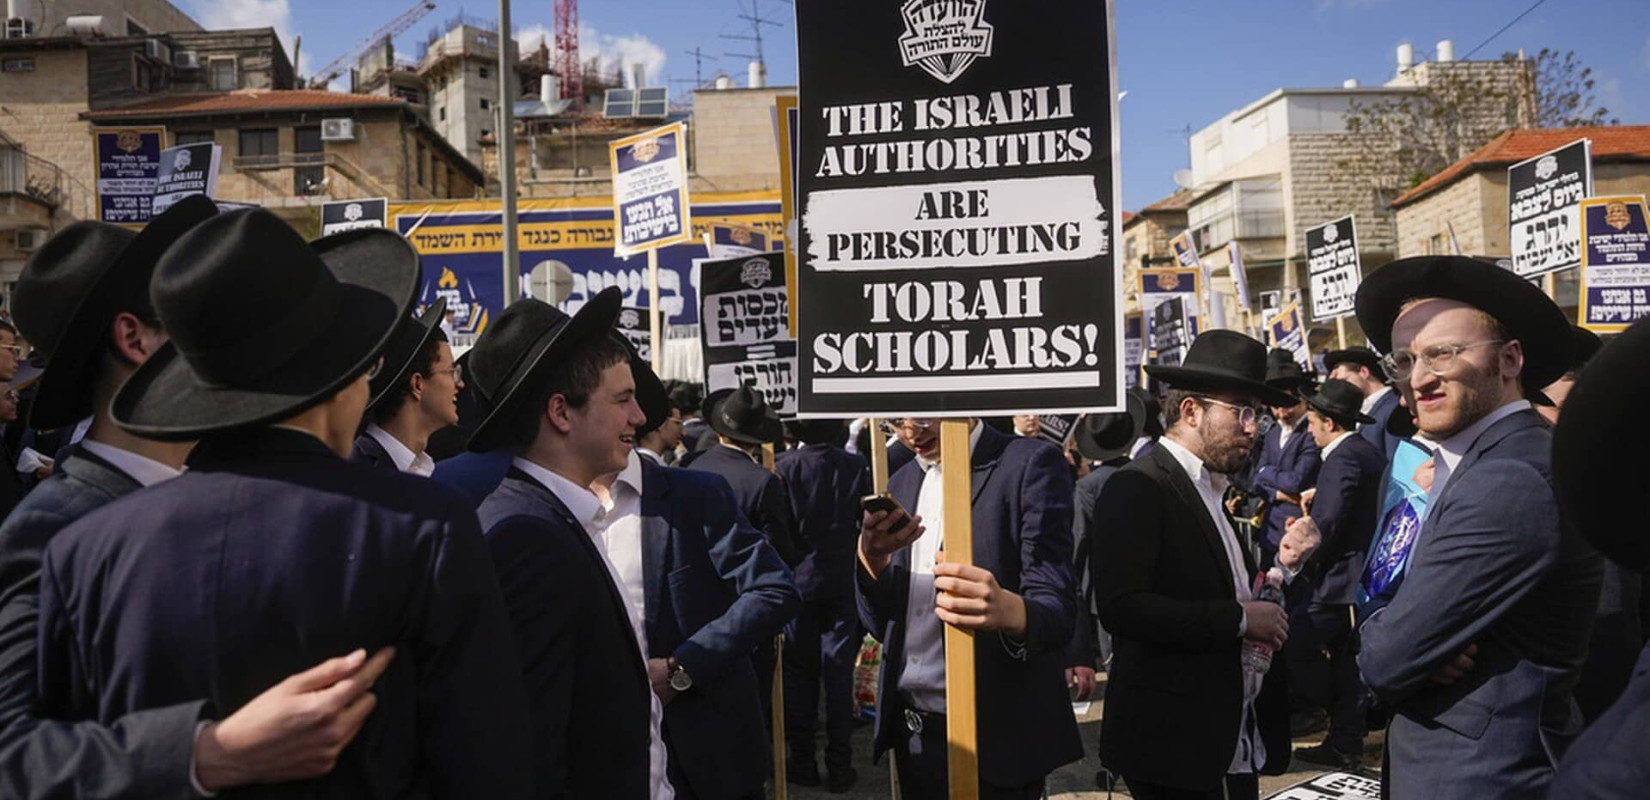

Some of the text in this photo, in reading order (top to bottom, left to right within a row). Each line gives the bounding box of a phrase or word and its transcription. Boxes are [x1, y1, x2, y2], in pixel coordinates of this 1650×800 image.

[924, 20, 966, 38] להצלת
[908, 33, 984, 57] עולם התורה
[822, 84, 1074, 137] THE ISRAELI
[815, 127, 1093, 177] AUTHORITIES
[915, 189, 989, 220] ARE
[416, 232, 466, 248] השמד
[472, 231, 503, 246] ירת
[523, 229, 561, 244] כנגד
[827, 222, 1081, 261] PERSECUTING
[863, 276, 1043, 323] TORAH
[813, 323, 1099, 374] SCHOLARS!
